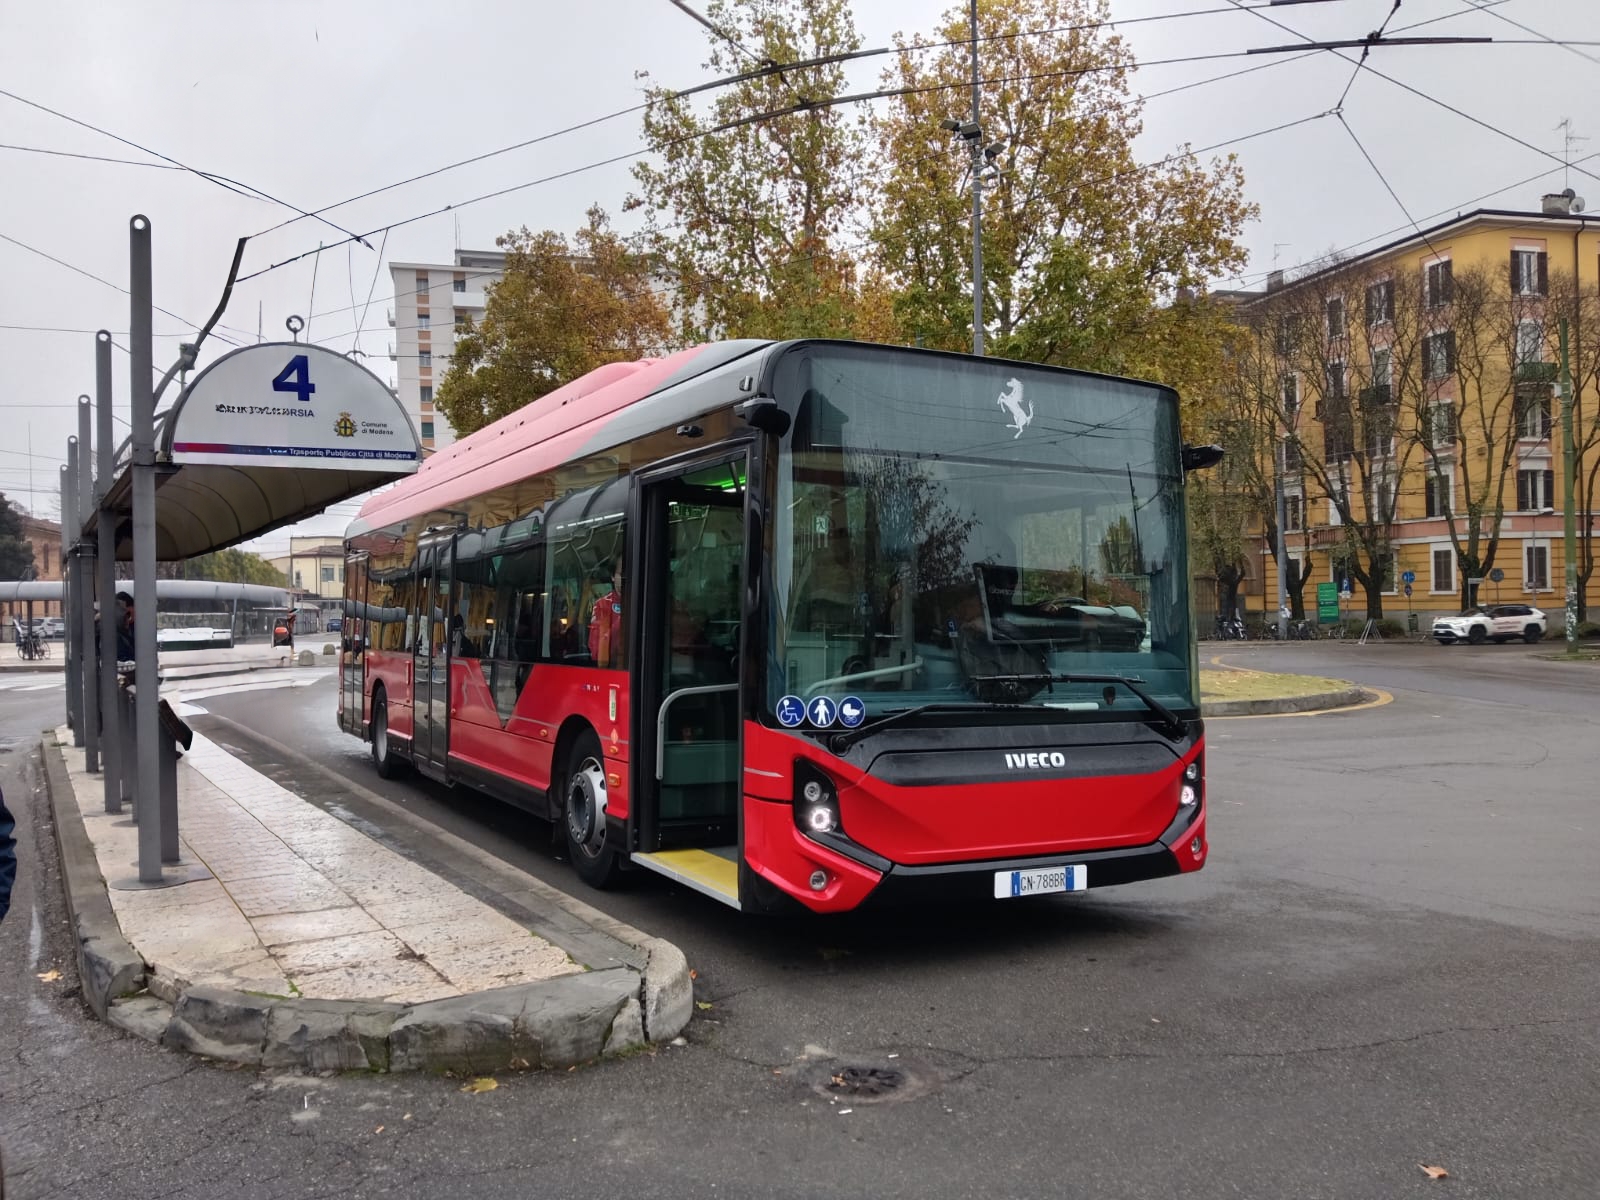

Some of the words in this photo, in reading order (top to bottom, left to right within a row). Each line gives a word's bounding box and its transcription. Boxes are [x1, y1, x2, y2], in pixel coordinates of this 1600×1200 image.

[272, 354, 315, 402] 4
[361, 420, 388, 429] Comune
[369, 428, 394, 436] Modena
[289, 447, 324, 457] Trasporto
[325, 448, 357, 458] Pubblico
[376, 451, 383, 459] di
[384, 452, 412, 460] Modena
[1005, 752, 1066, 769] IVECO
